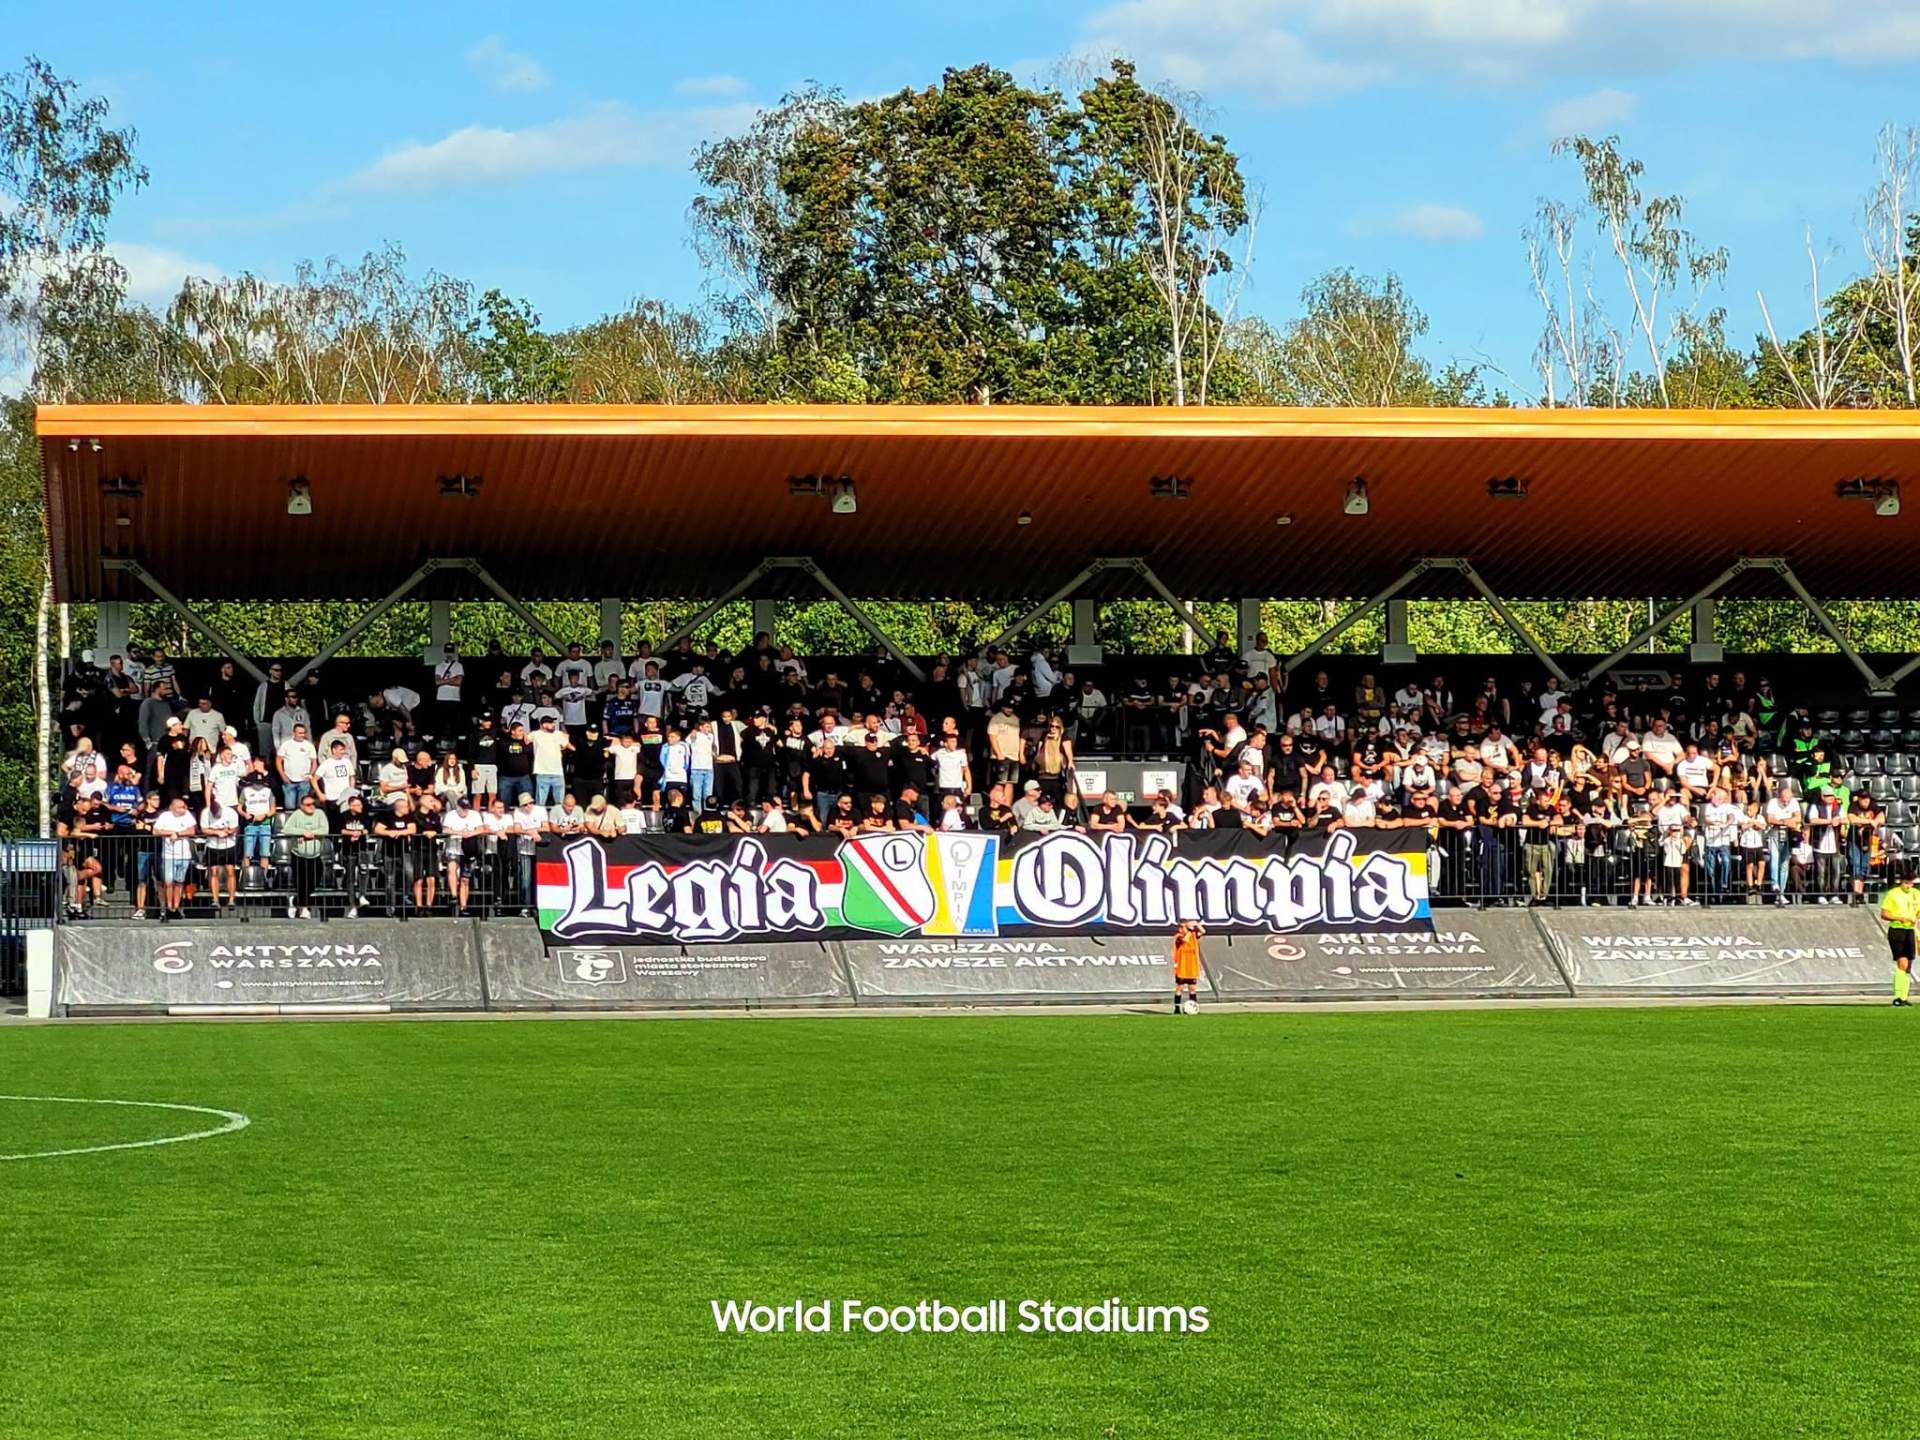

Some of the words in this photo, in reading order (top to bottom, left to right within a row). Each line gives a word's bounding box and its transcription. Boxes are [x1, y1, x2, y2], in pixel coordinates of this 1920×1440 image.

[893, 845, 907, 865] L
[1012, 829, 1417, 932] Olimpia
[552, 836, 827, 943] Legia
[1317, 931, 1481, 944] AKTYWNA
[1582, 935, 1763, 947] WARSZAWA.
[209, 944, 381, 957] AKTYWNA
[878, 942, 1066, 955] WARSZAWA.
[1319, 944, 1487, 956] WARSZAWA
[1591, 949, 1711, 961] ZAWSZE
[1717, 947, 1865, 960] AKTYWNIE
[209, 957, 382, 969] WARSZAWA
[882, 956, 1005, 969] ZAWSZE
[1015, 954, 1169, 968] AKTYWNIE
